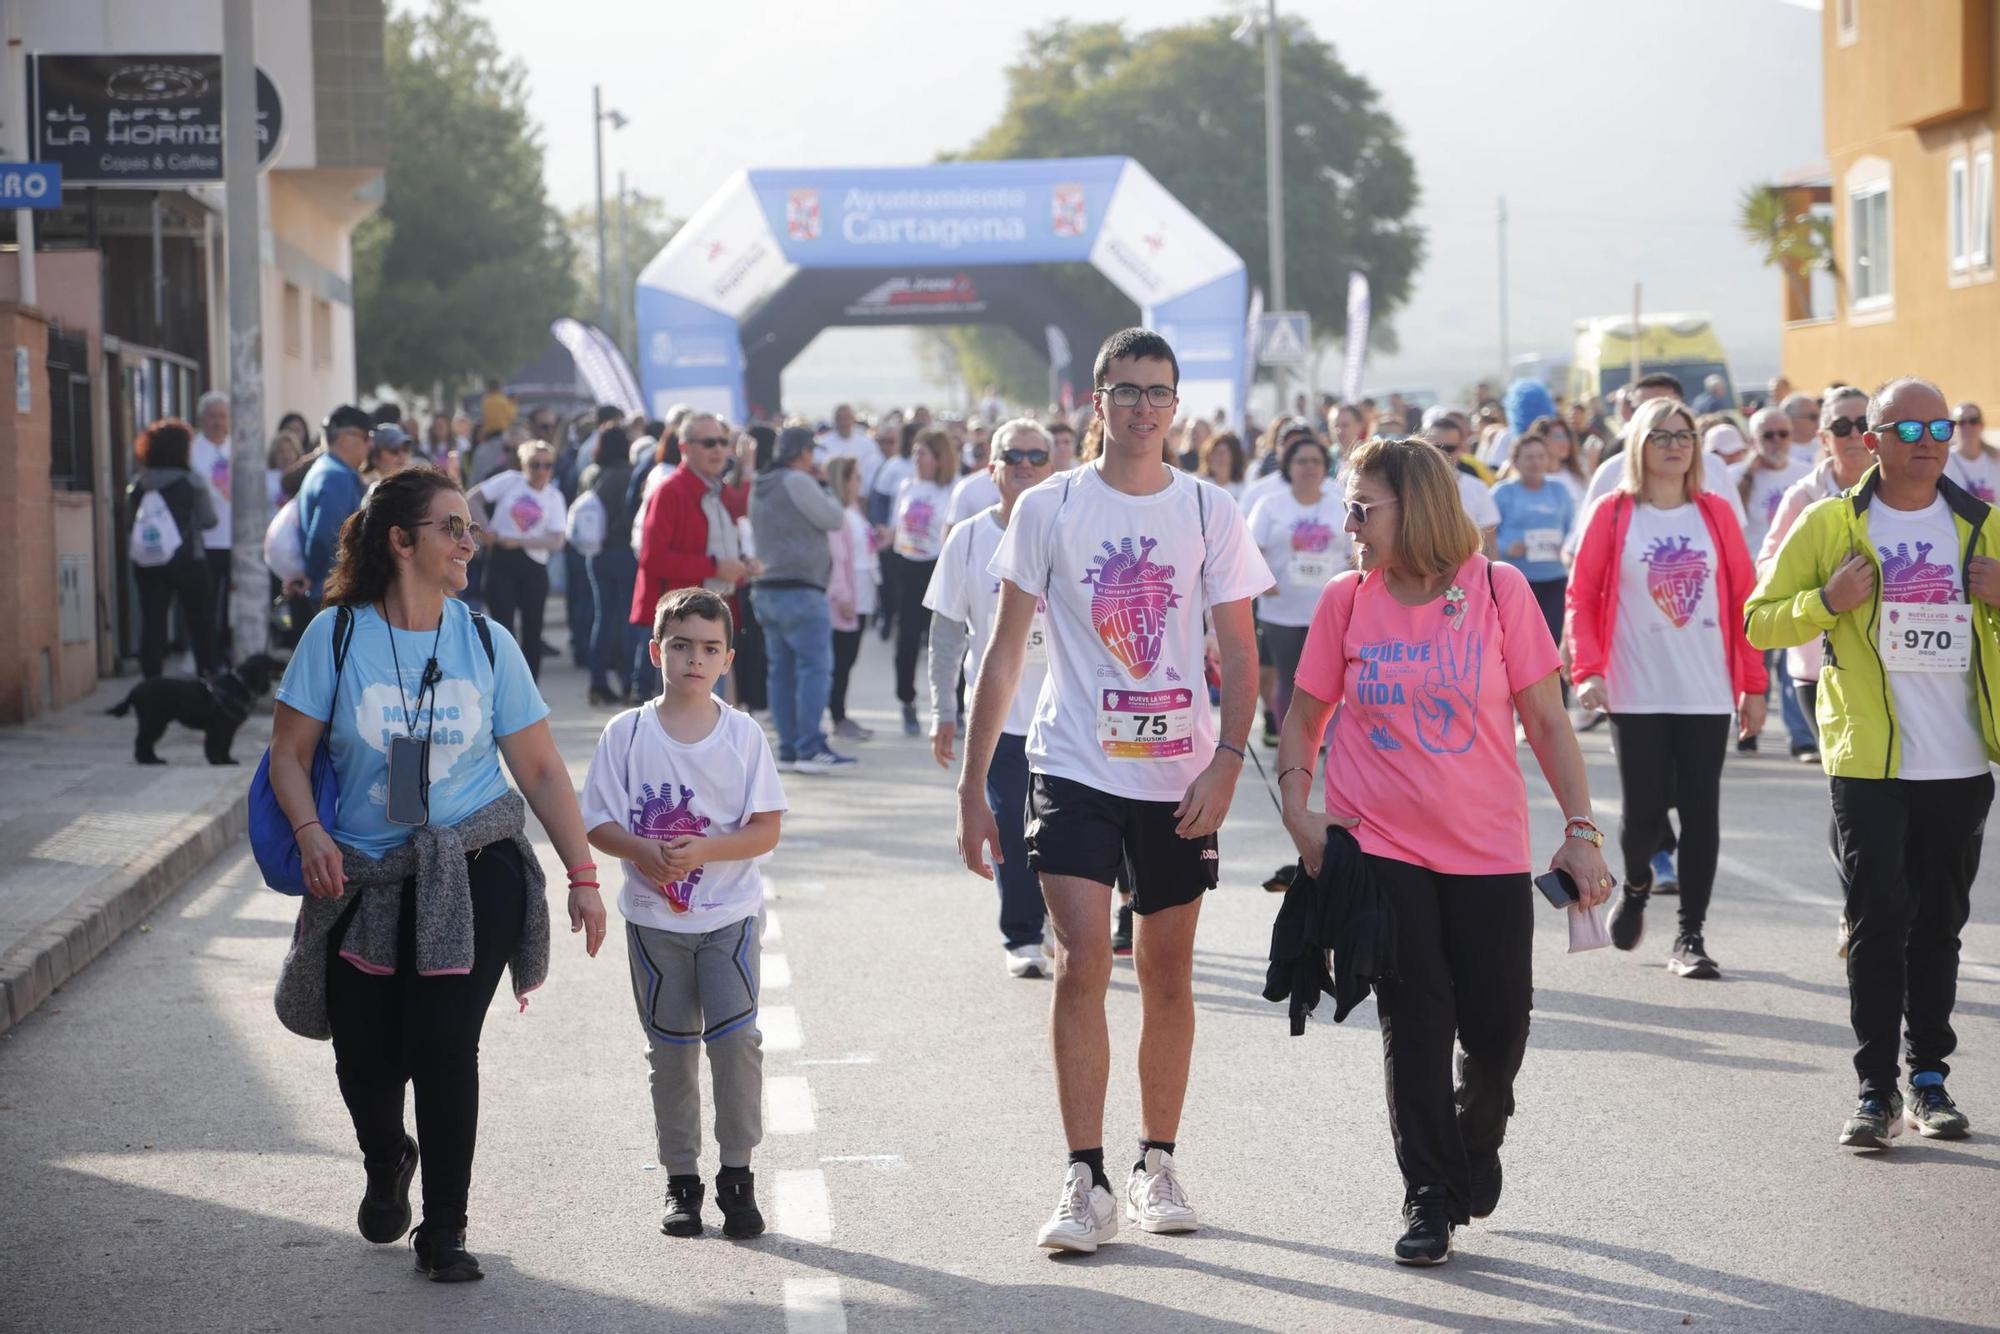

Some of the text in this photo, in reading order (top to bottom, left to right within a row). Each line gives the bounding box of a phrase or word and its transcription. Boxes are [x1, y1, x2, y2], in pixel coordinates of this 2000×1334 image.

[46, 123, 269, 146] LA HORMIA
[167, 153, 218, 170] Coffee
[0, 171, 48, 199] RO
[843, 187, 1027, 212] Ayuntamiento
[841, 210, 1027, 250] Cartagena
[1652, 579, 1704, 604] MUEVE
[1099, 606, 1167, 648] MUEVE
[1904, 629, 1952, 650] 970
[1107, 636, 1162, 669] VIDA
[1128, 695, 1149, 703] MUEVE
[1356, 683, 1405, 705] VIDA
[1133, 714, 1168, 736] 75
